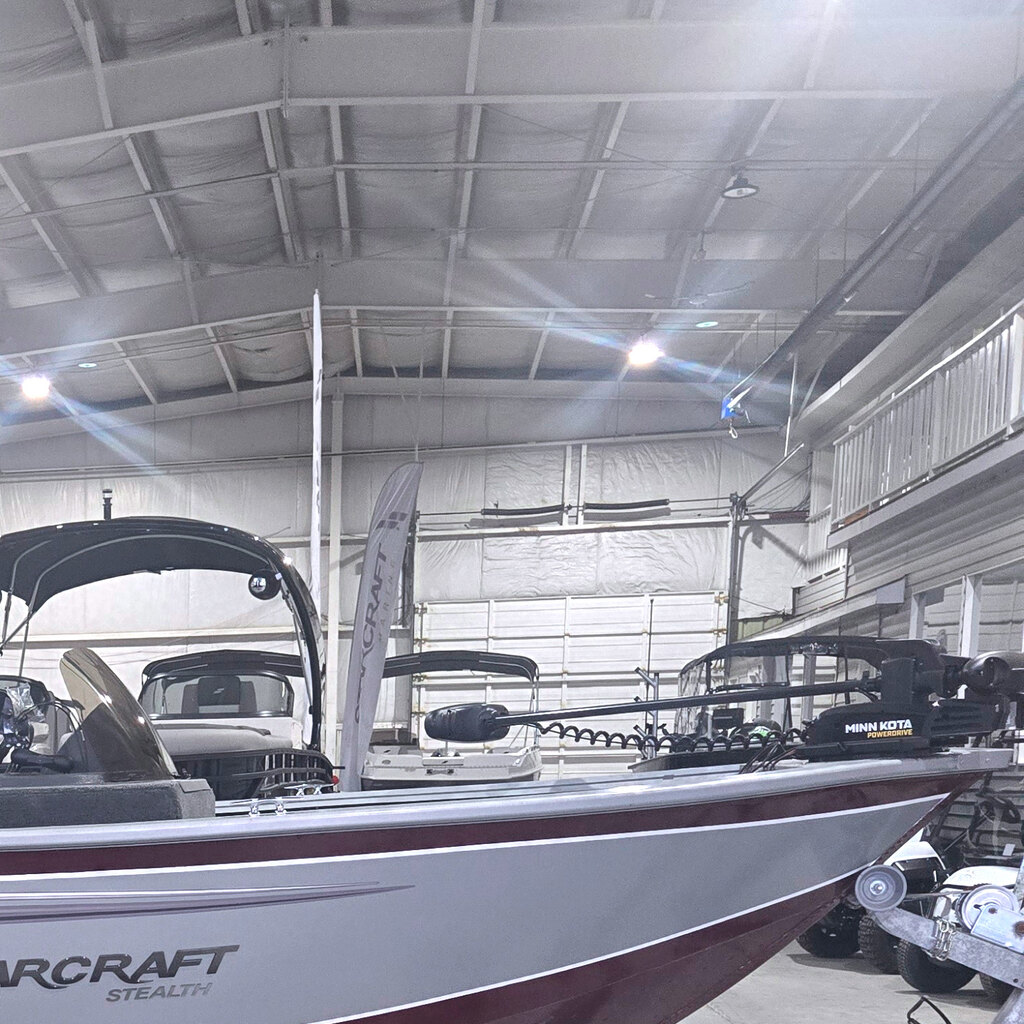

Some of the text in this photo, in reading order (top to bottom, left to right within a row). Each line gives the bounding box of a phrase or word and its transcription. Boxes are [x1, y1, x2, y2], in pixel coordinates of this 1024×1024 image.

[845, 719, 913, 734] MINN KOTA
[867, 729, 913, 739] POWERDRIVE
[105, 982, 214, 1003] STEALTH
